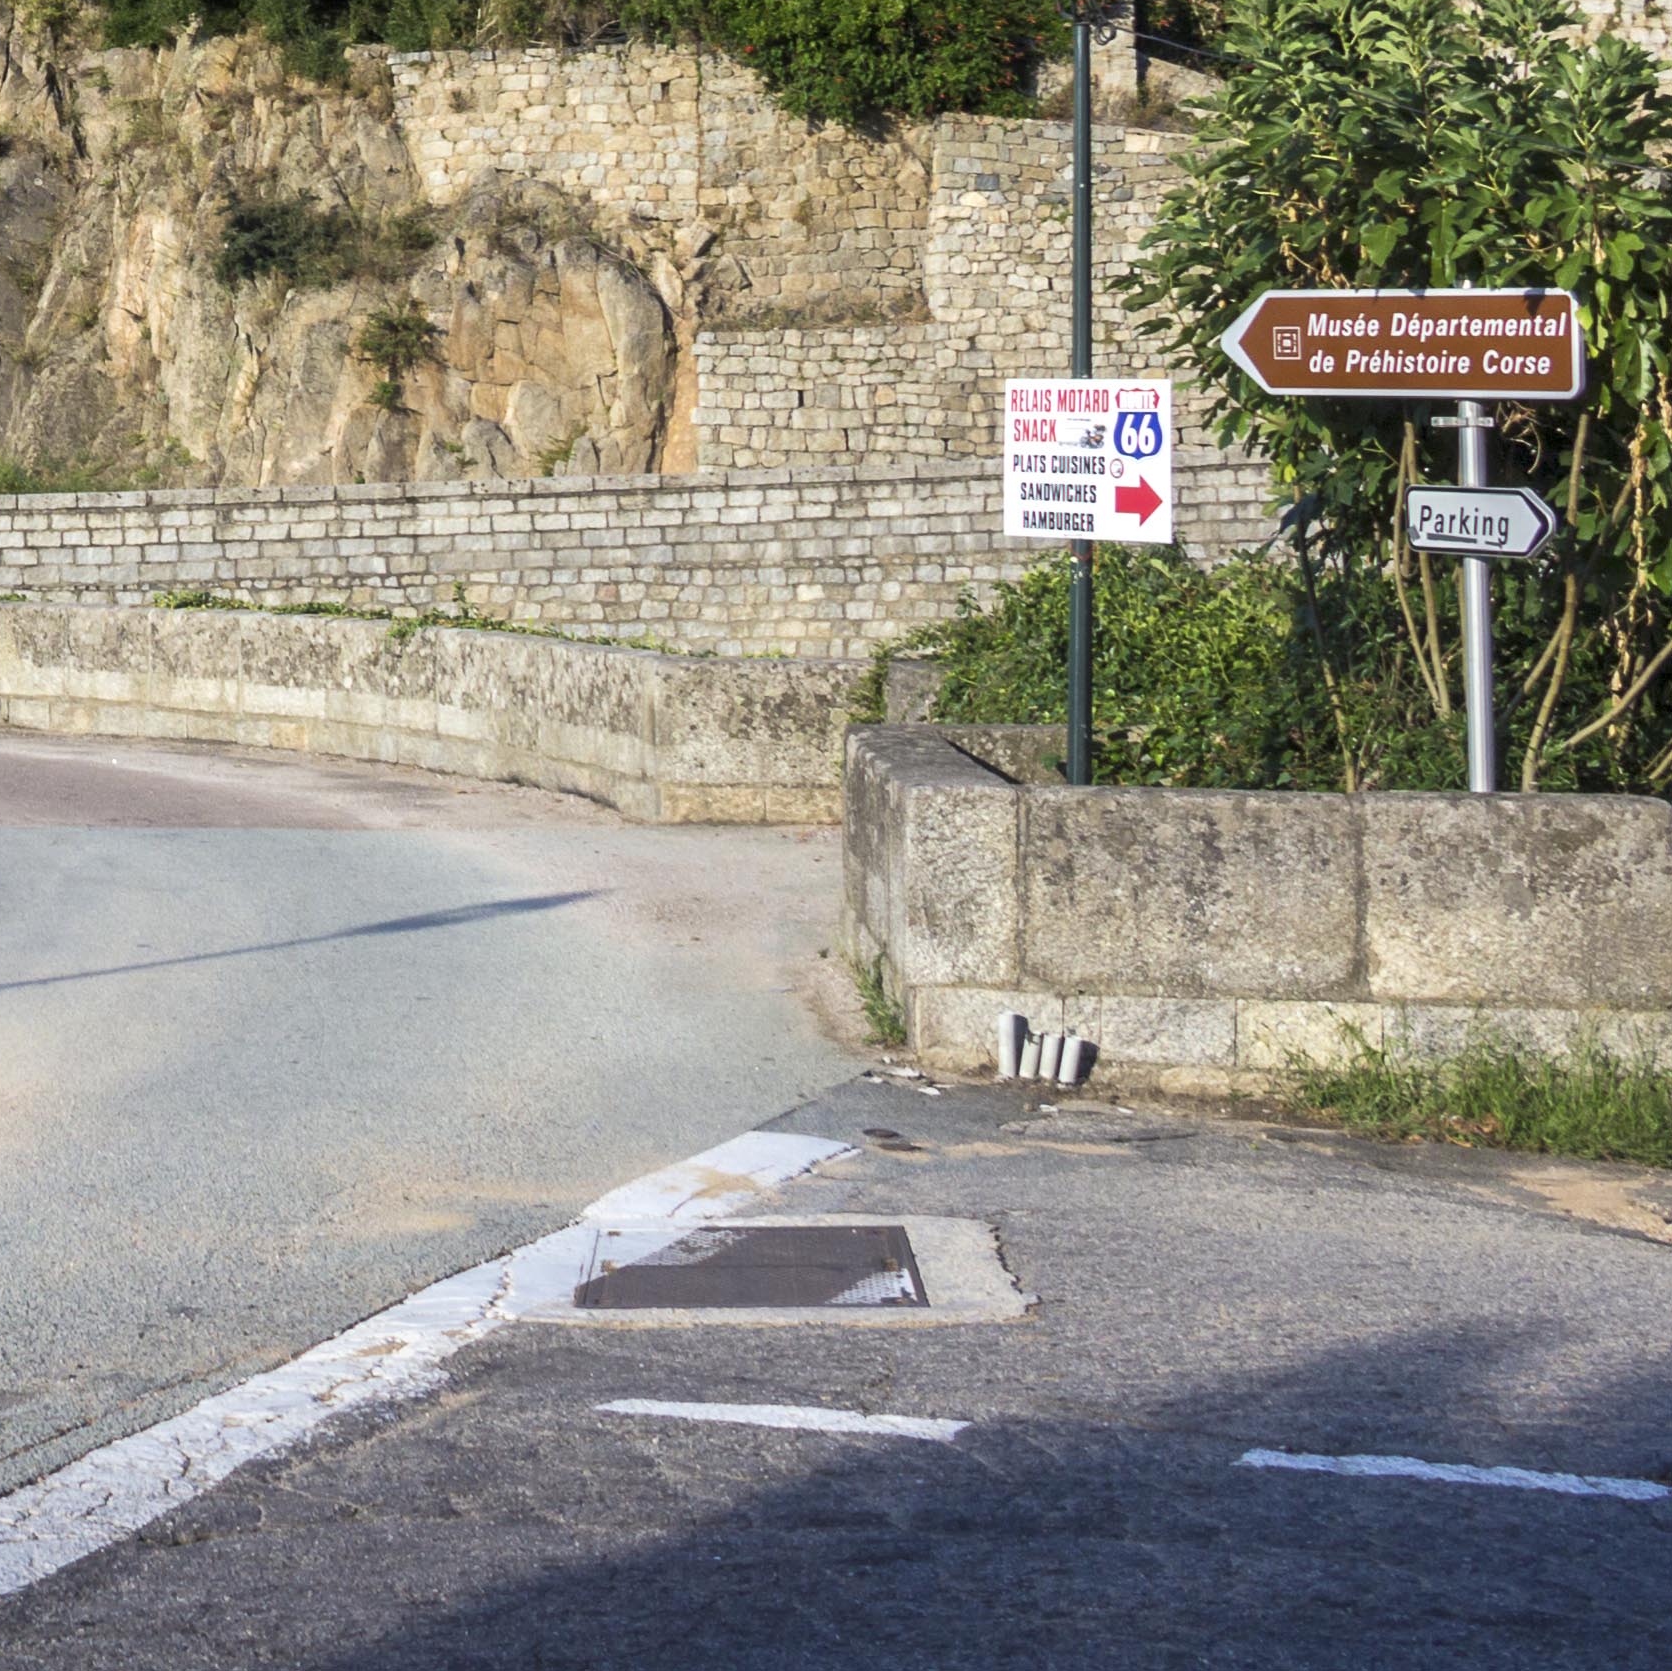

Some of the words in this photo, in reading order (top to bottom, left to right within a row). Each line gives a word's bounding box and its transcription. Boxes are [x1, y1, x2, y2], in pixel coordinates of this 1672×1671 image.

[1307, 312, 1380, 337] Musée
[1391, 312, 1567, 343] Départemental
[1309, 350, 1335, 374] de
[1345, 350, 1471, 375] Préhistoire
[1483, 350, 1551, 375] Corse
[1011, 389, 1051, 412] RELAIS
[1057, 389, 1109, 413] MOTARD
[1013, 419, 1057, 442] SNACK
[1121, 414, 1155, 454] 66
[1013, 454, 1046, 473] PLATS
[1051, 455, 1105, 475] CUISINES
[1020, 482, 1097, 503] SANDWICHES
[1023, 510, 1095, 532] HAMBURGER
[1419, 504, 1509, 546] Parking
